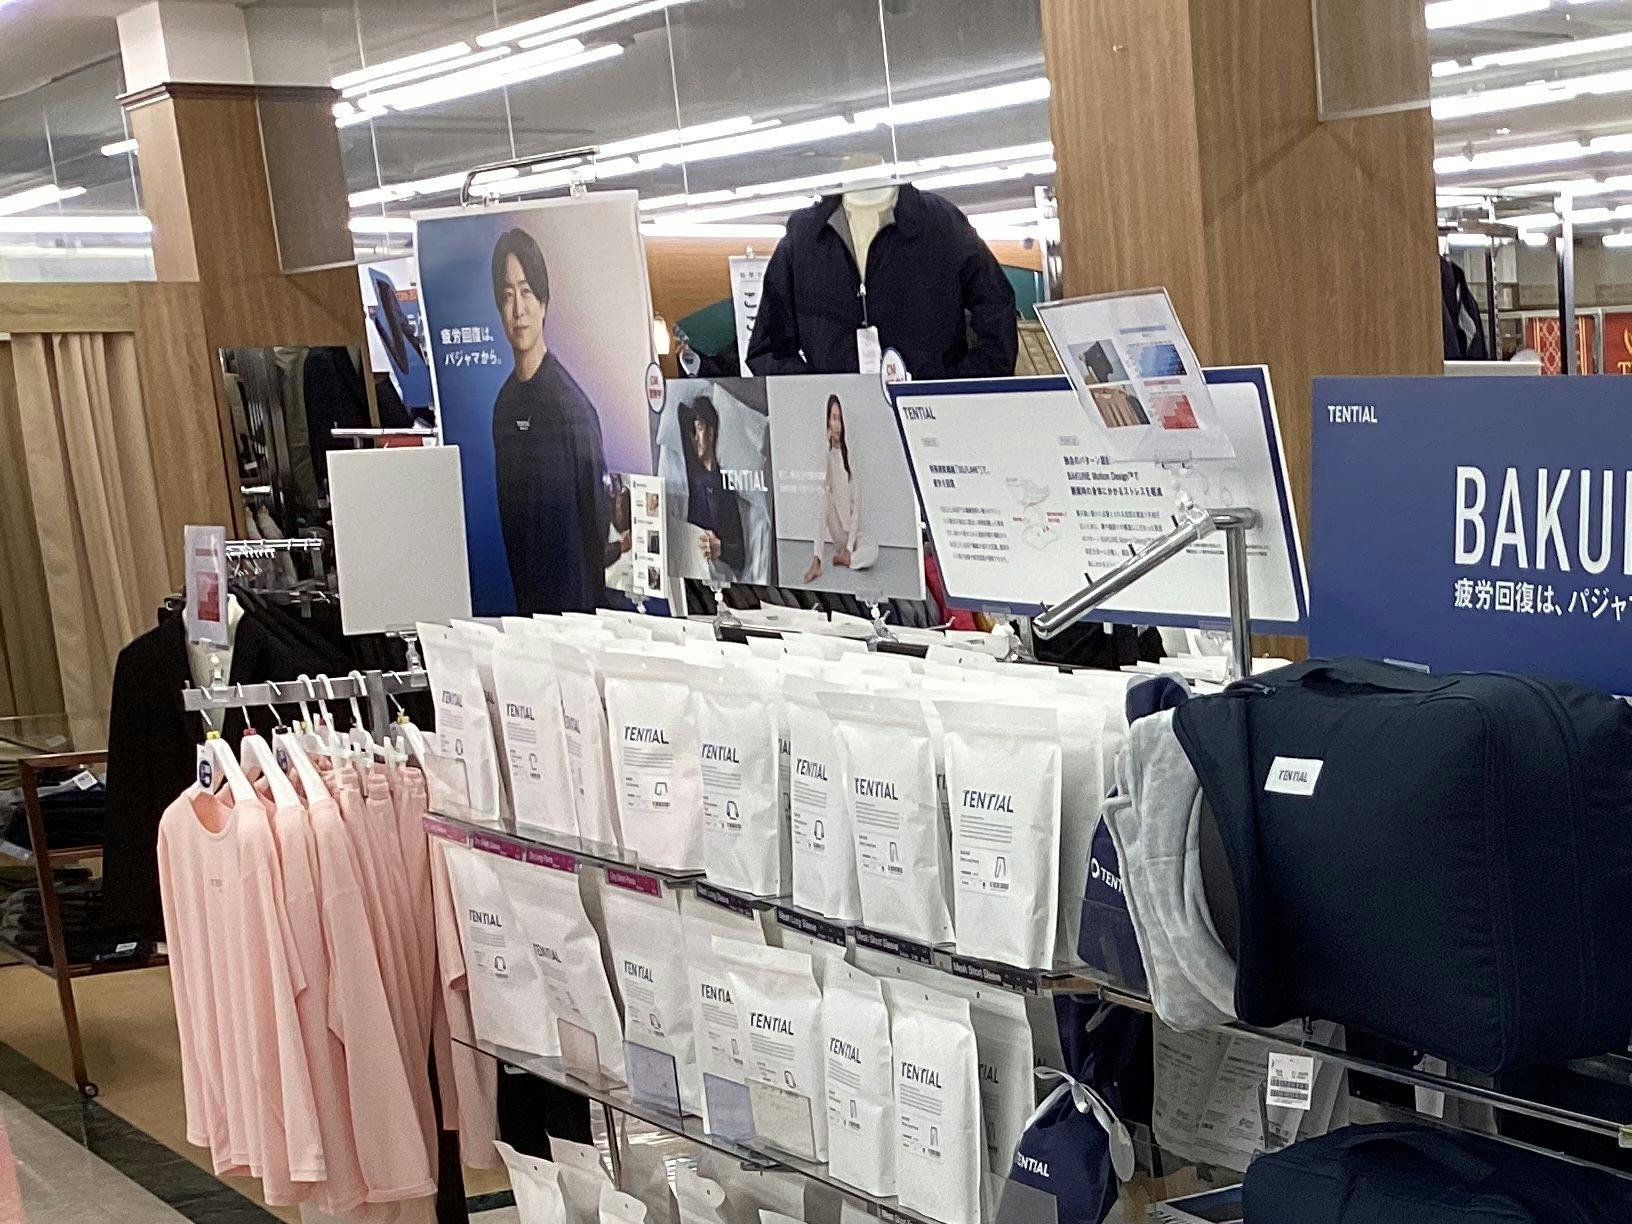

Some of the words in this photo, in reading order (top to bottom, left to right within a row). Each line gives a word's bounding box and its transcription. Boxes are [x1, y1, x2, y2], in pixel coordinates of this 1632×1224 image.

[902, 406, 936, 421] TENTIAL
[1327, 405, 1378, 425] TENTIAL
[719, 469, 768, 492] TENTIAL
[506, 703, 535, 721] TENTIAL
[624, 726, 670, 745] TENTIAL
[701, 743, 739, 764] TENTIAL
[796, 757, 828, 781] TENTIAL
[1277, 768, 1308, 784] TENTIAL
[854, 777, 899, 801] TENTIAL
[962, 789, 1014, 814] TENTIAL
[469, 909, 502, 927] TENTIAL
[624, 960, 654, 983] TENTIAL
[701, 984, 734, 1004] TENTIA
[750, 1012, 794, 1035] TENTIAL
[830, 1037, 862, 1064] TENTIAL
[901, 1061, 942, 1089] TENTIAL
